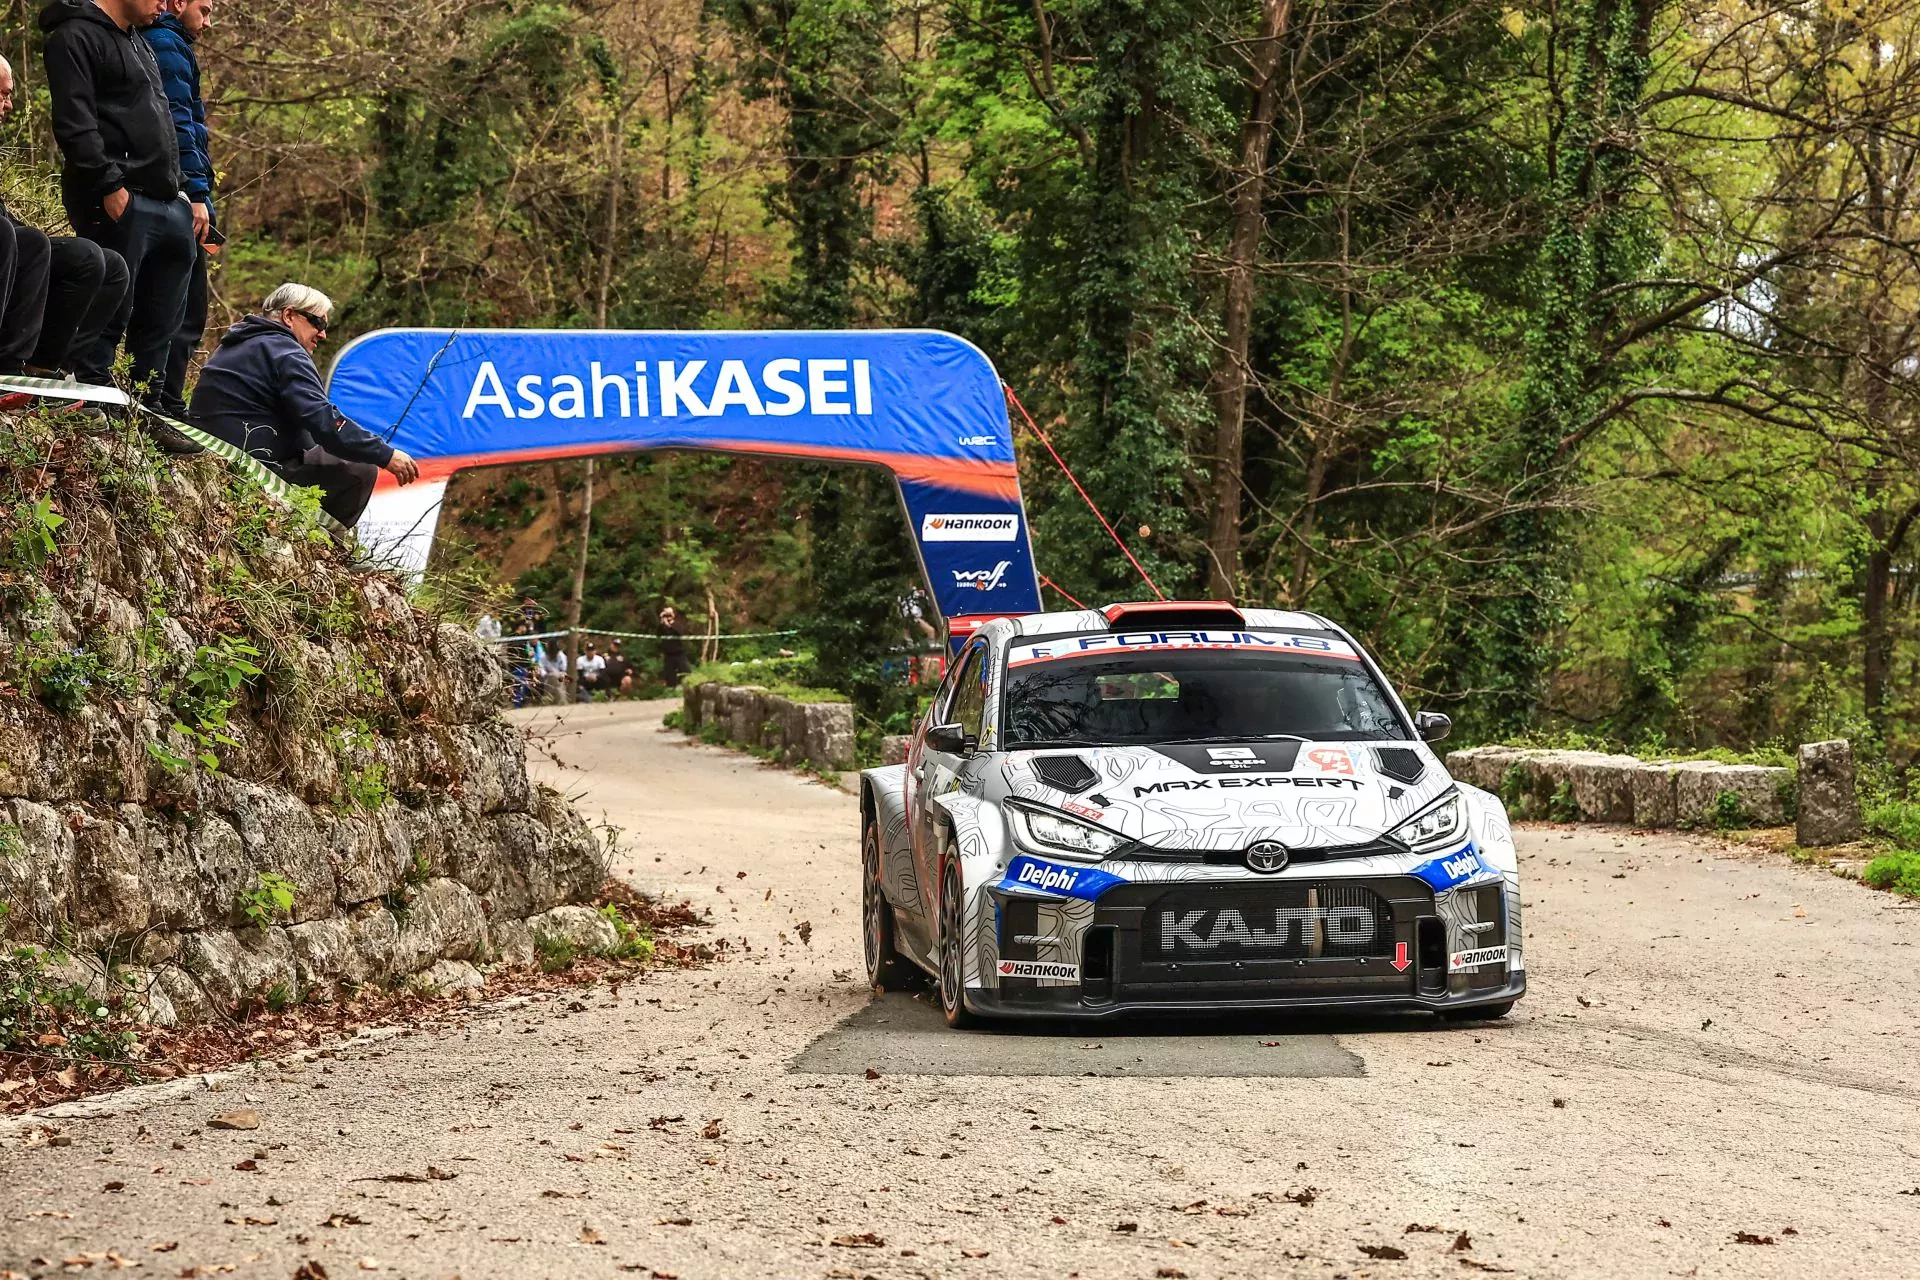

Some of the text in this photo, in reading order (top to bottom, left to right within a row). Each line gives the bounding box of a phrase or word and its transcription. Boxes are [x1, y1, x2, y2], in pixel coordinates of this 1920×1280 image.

[958, 435, 997, 446] WRC
[1133, 777, 1365, 797] MAX EXPERT
[1018, 862, 1079, 891] Delphi
[1441, 849, 1481, 880] Delphi
